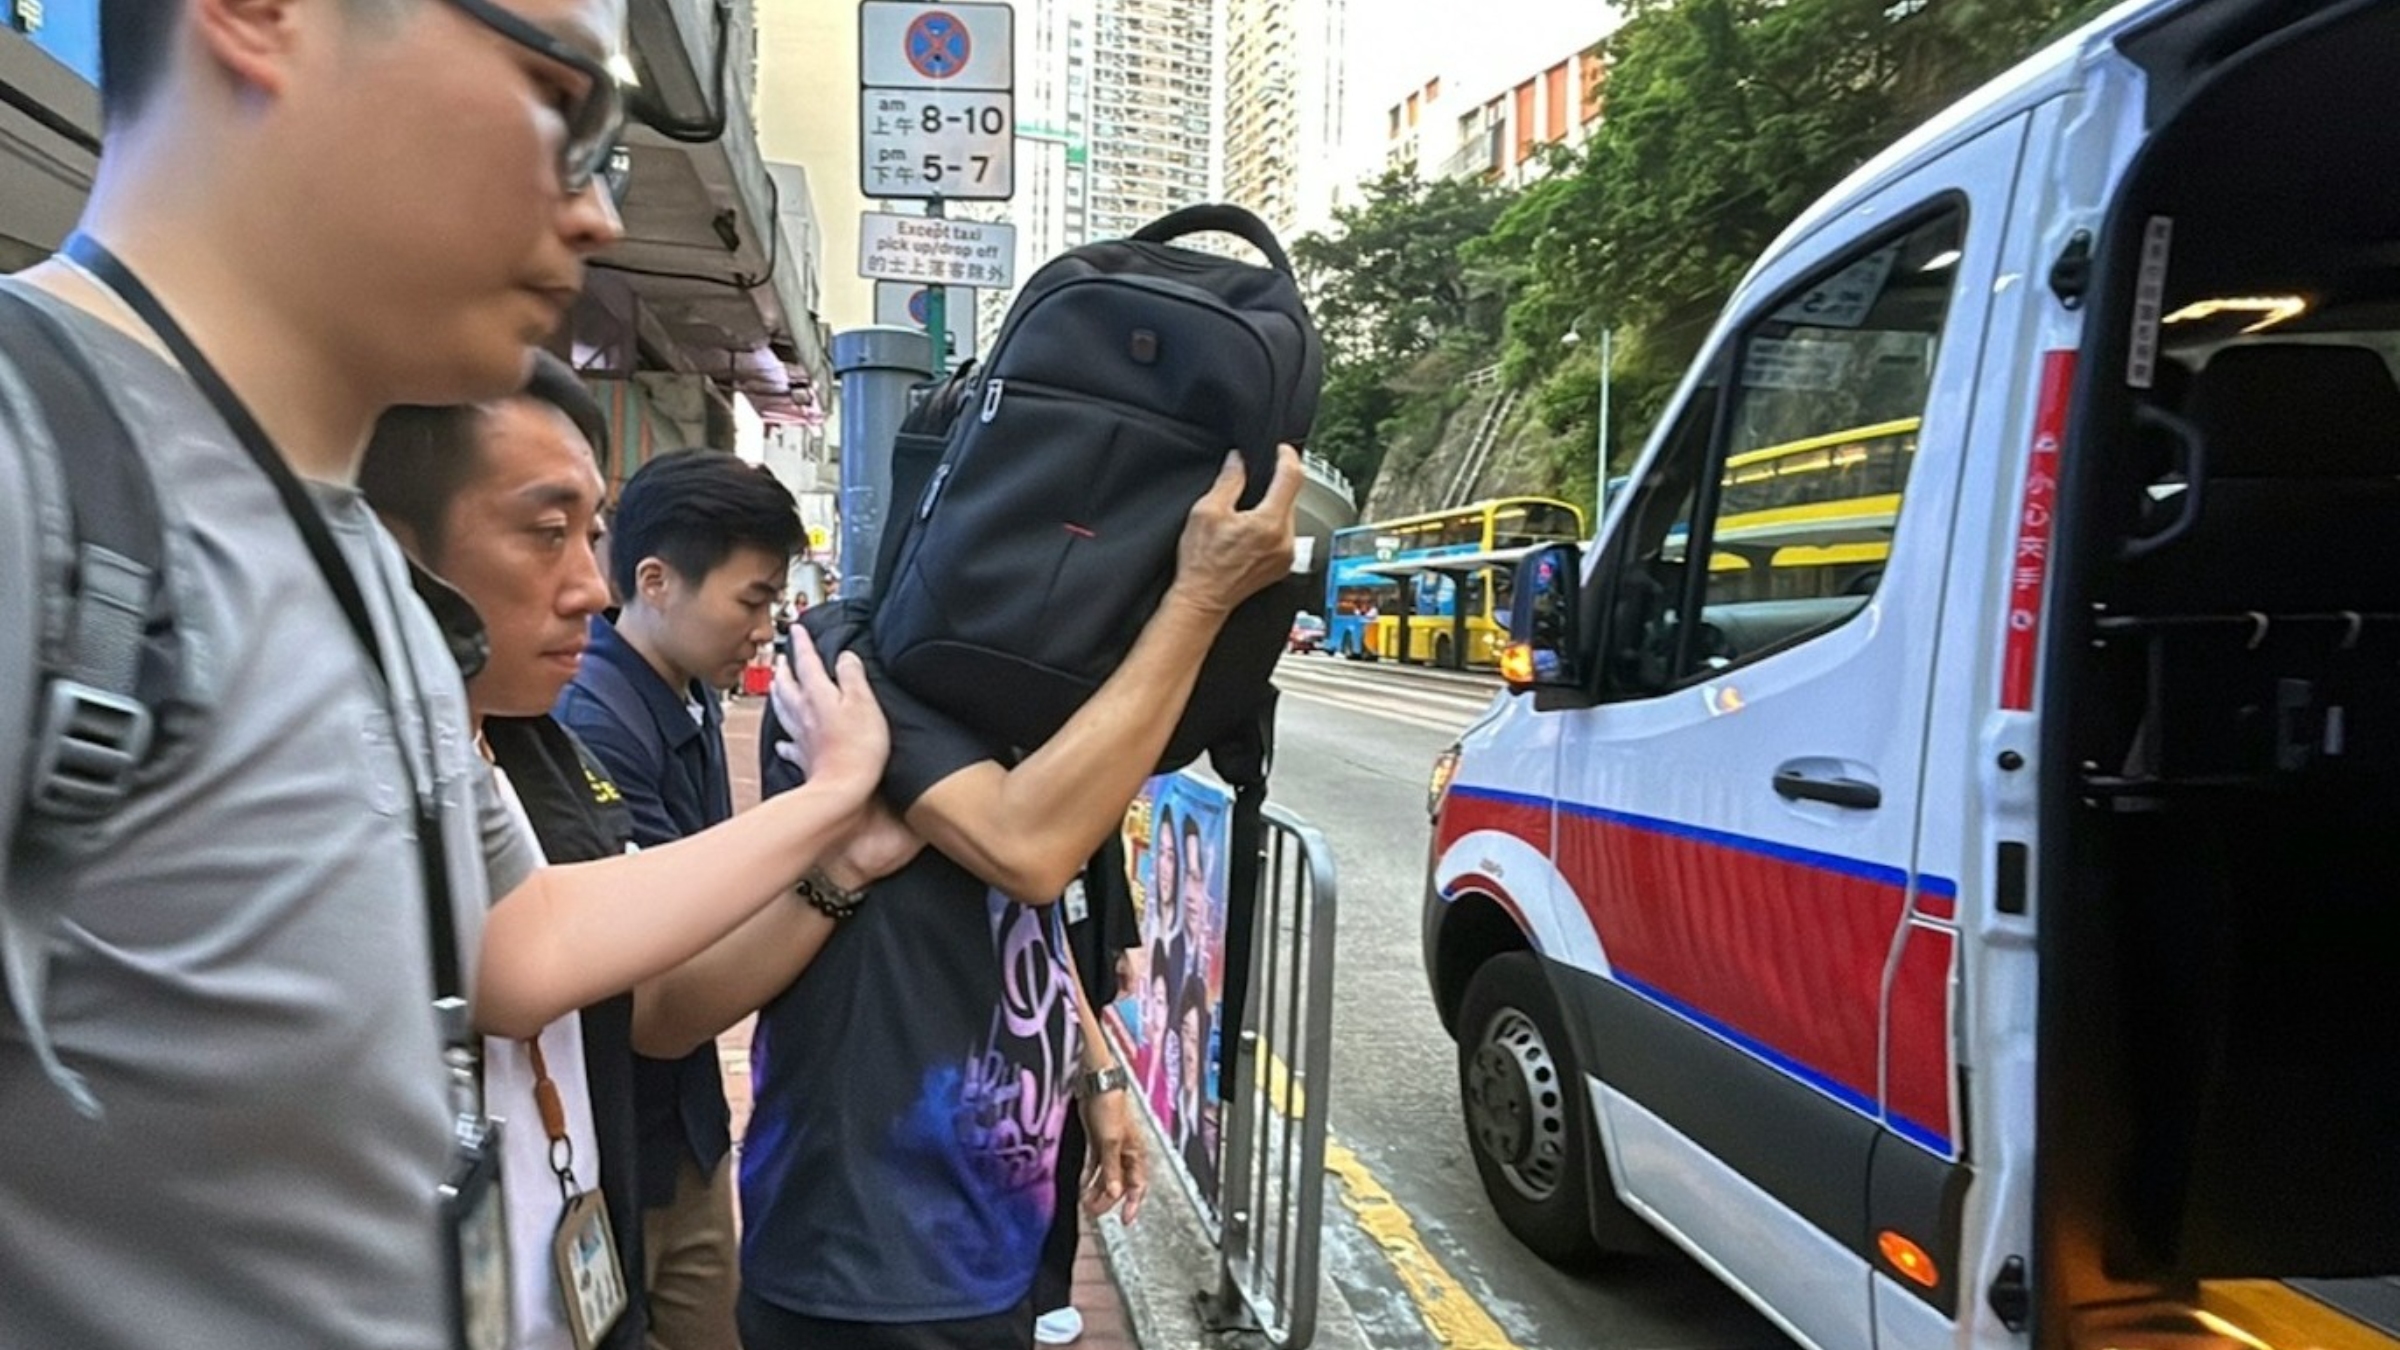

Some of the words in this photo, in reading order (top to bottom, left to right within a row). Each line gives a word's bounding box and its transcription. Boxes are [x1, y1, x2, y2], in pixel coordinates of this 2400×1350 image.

[878, 99, 906, 112] am
[870, 116, 915, 136] 上午
[921, 104, 1004, 135] 8-10
[878, 149, 907, 162] pm
[870, 166, 915, 185] 下午
[898, 221, 950, 239] Except
[953, 226, 982, 241] taxi
[876, 236, 909, 251] pick
[913, 241, 972, 258] up/drop
[976, 245, 999, 259] off
